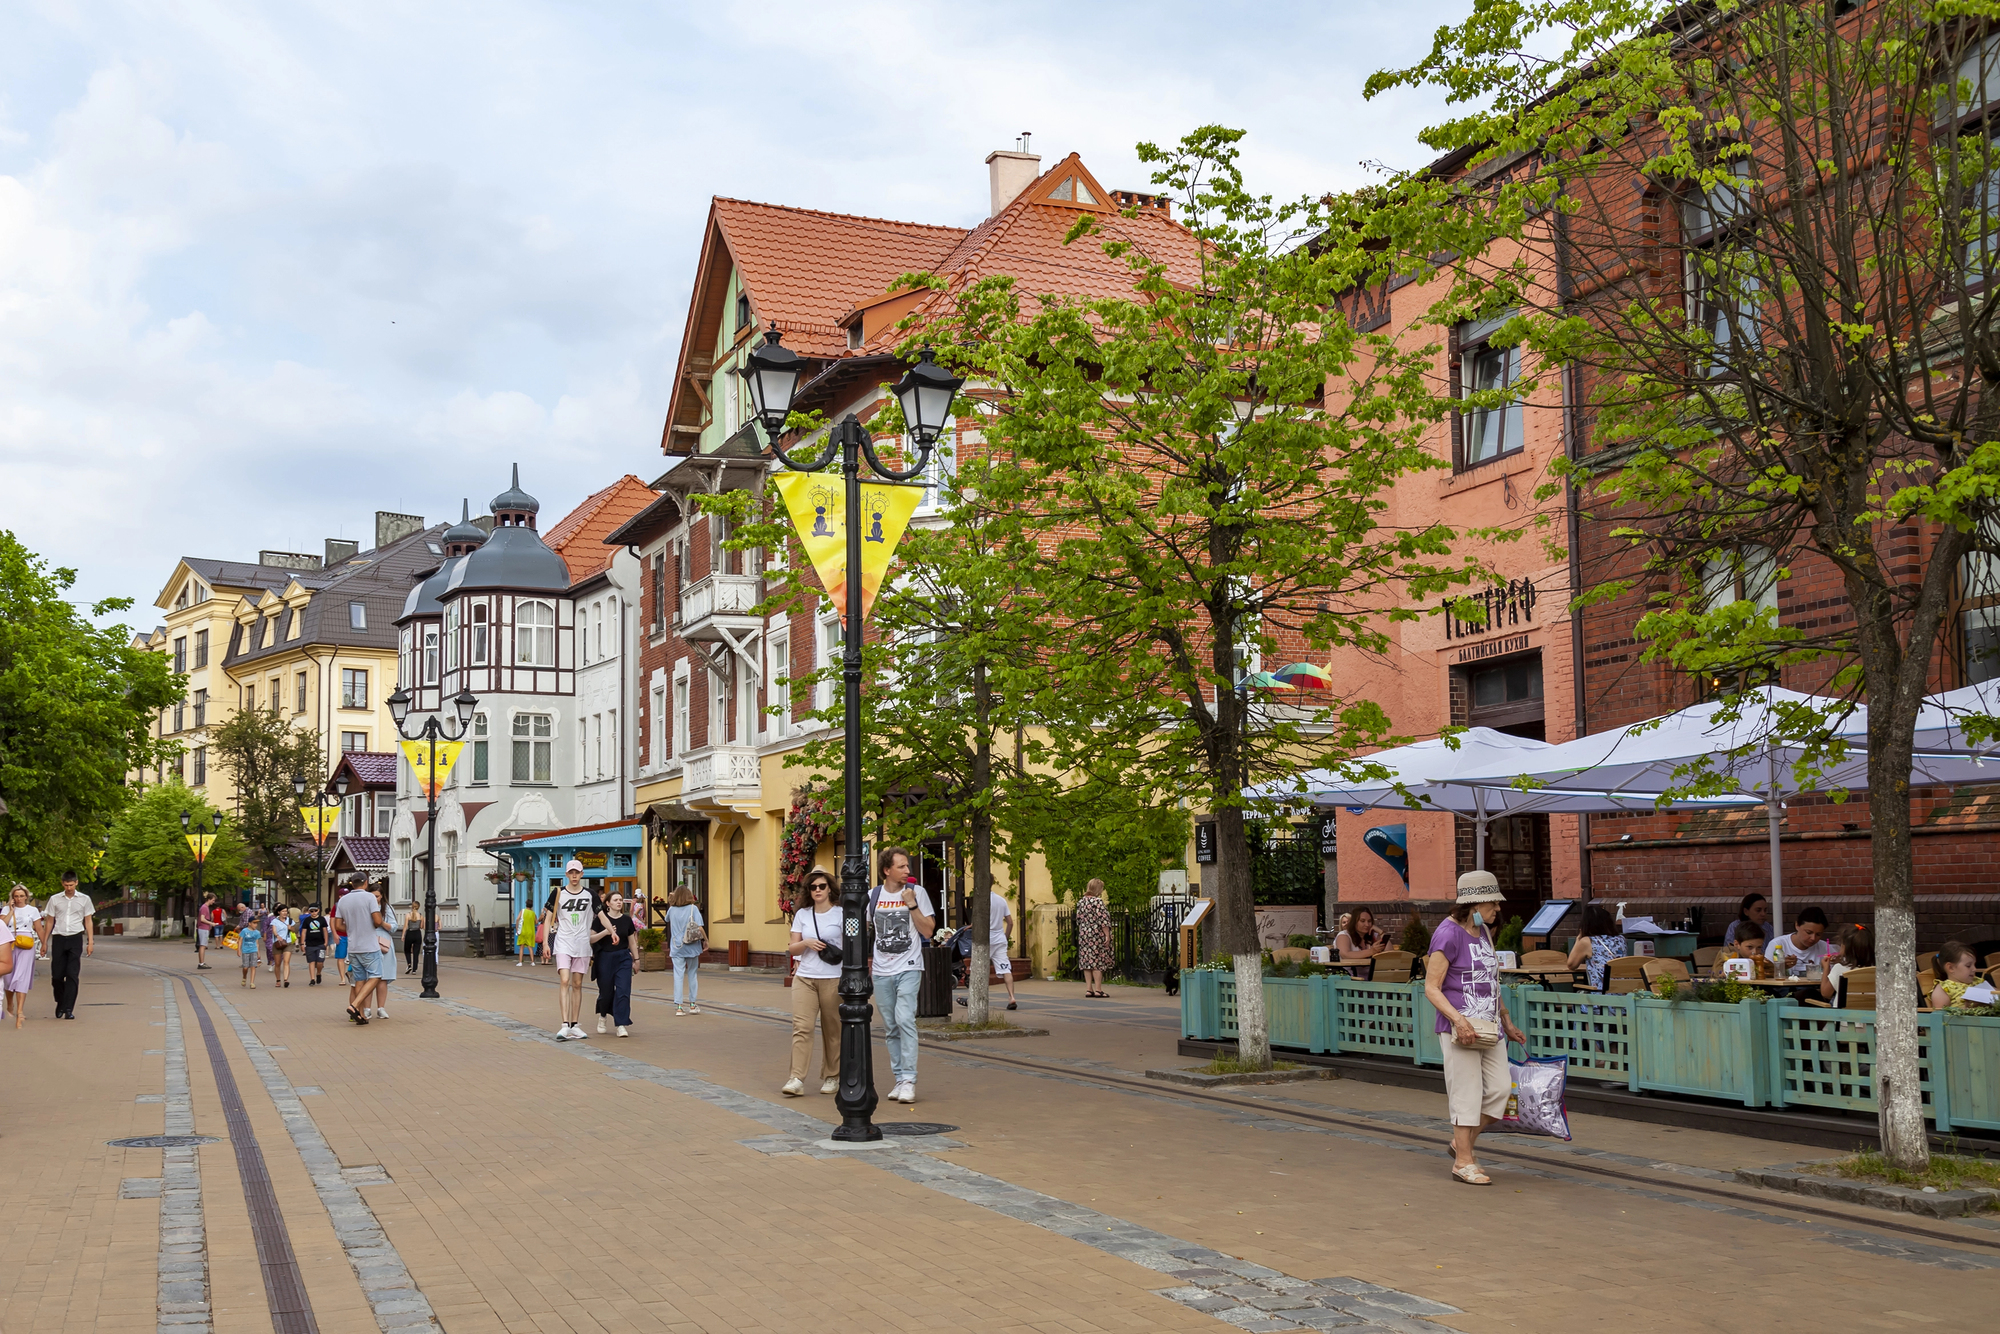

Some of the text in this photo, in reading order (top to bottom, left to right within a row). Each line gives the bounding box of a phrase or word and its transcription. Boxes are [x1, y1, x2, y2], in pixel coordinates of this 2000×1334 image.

[1459, 635, 1529, 662] БАЛТИЙСКАЯ КУХНЯ
[1197, 854, 1211, 862] COFFEE
[561, 898, 590, 912] 46
